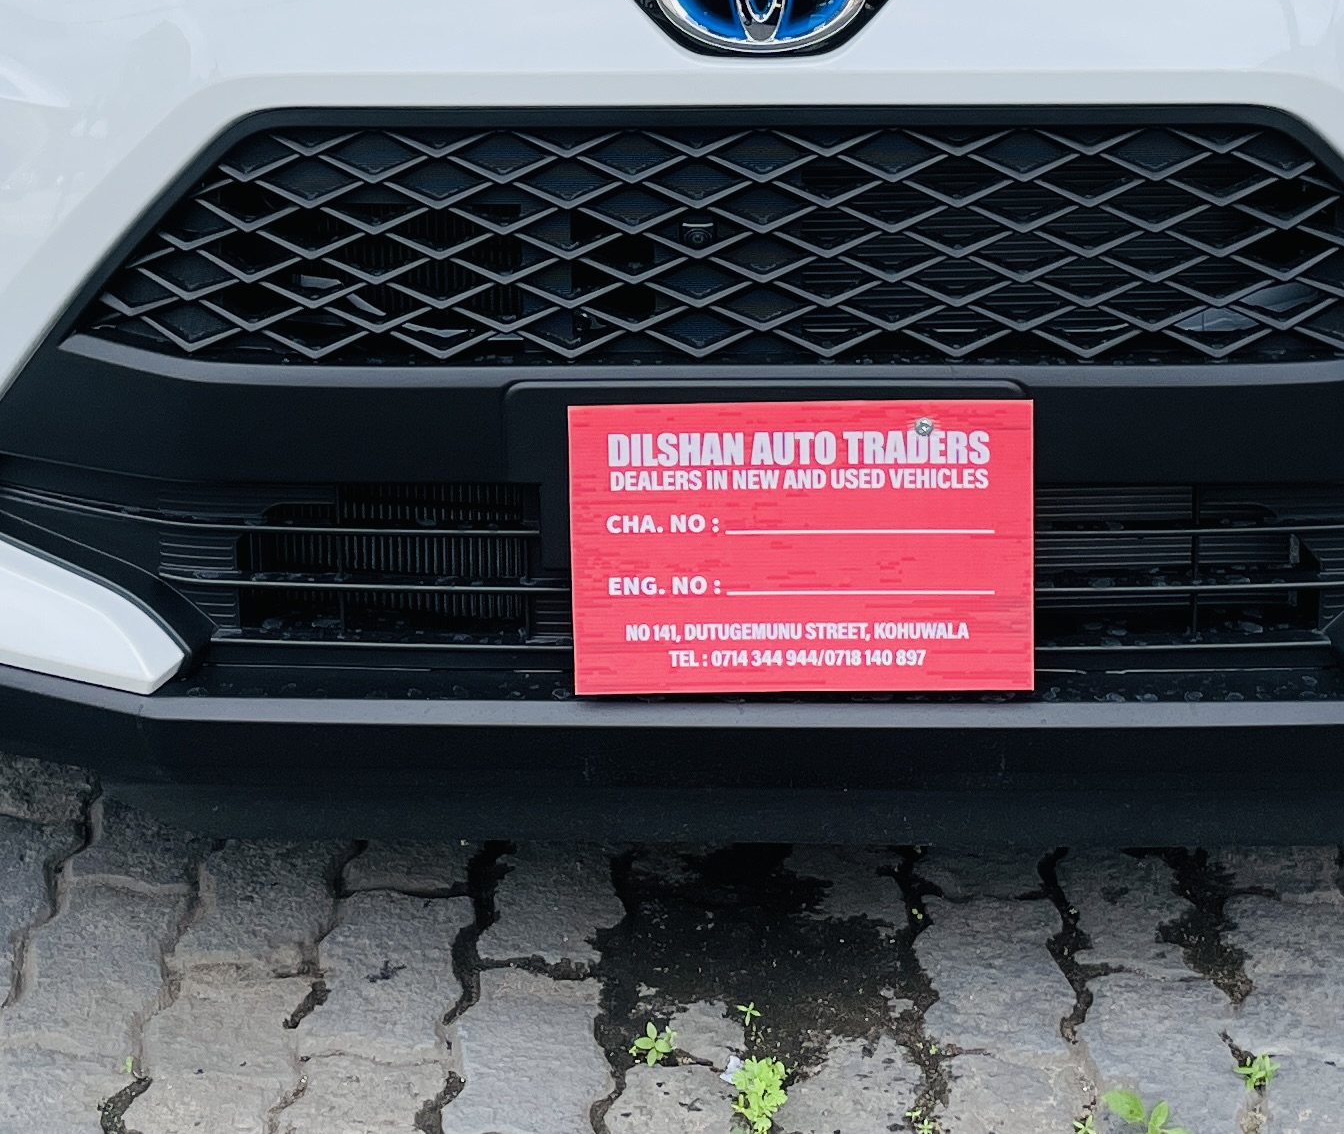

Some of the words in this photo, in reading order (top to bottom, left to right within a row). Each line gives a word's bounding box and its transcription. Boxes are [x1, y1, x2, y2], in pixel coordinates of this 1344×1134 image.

[607, 432, 745, 467] DILSHAN
[751, 431, 837, 466] AUTO
[843, 430, 991, 465] TRADERS
[610, 469, 703, 491] DEALERS
[706, 469, 728, 490] IN
[732, 469, 780, 490] NEW
[783, 468, 827, 489] AND
[830, 468, 886, 489] USED
[889, 468, 989, 489] VEHICLES
[606, 514, 664, 534] CHA.
[670, 513, 706, 533] NO
[608, 576, 666, 596] ENG.
[672, 575, 708, 595] NO
[626, 624, 650, 641] NO
[653, 623, 681, 643] 141,
[684, 623, 802, 640] DUTUGEMUNU
[805, 622, 871, 642] STREET,
[874, 621, 970, 639] KOHUWALA
[669, 650, 699, 667] TEL
[711, 650, 748, 666] 0714
[751, 650, 783, 666] 344
[786, 649, 862, 666] 944/0718
[865, 649, 892, 666] 140
[895, 649, 927, 666] 897
